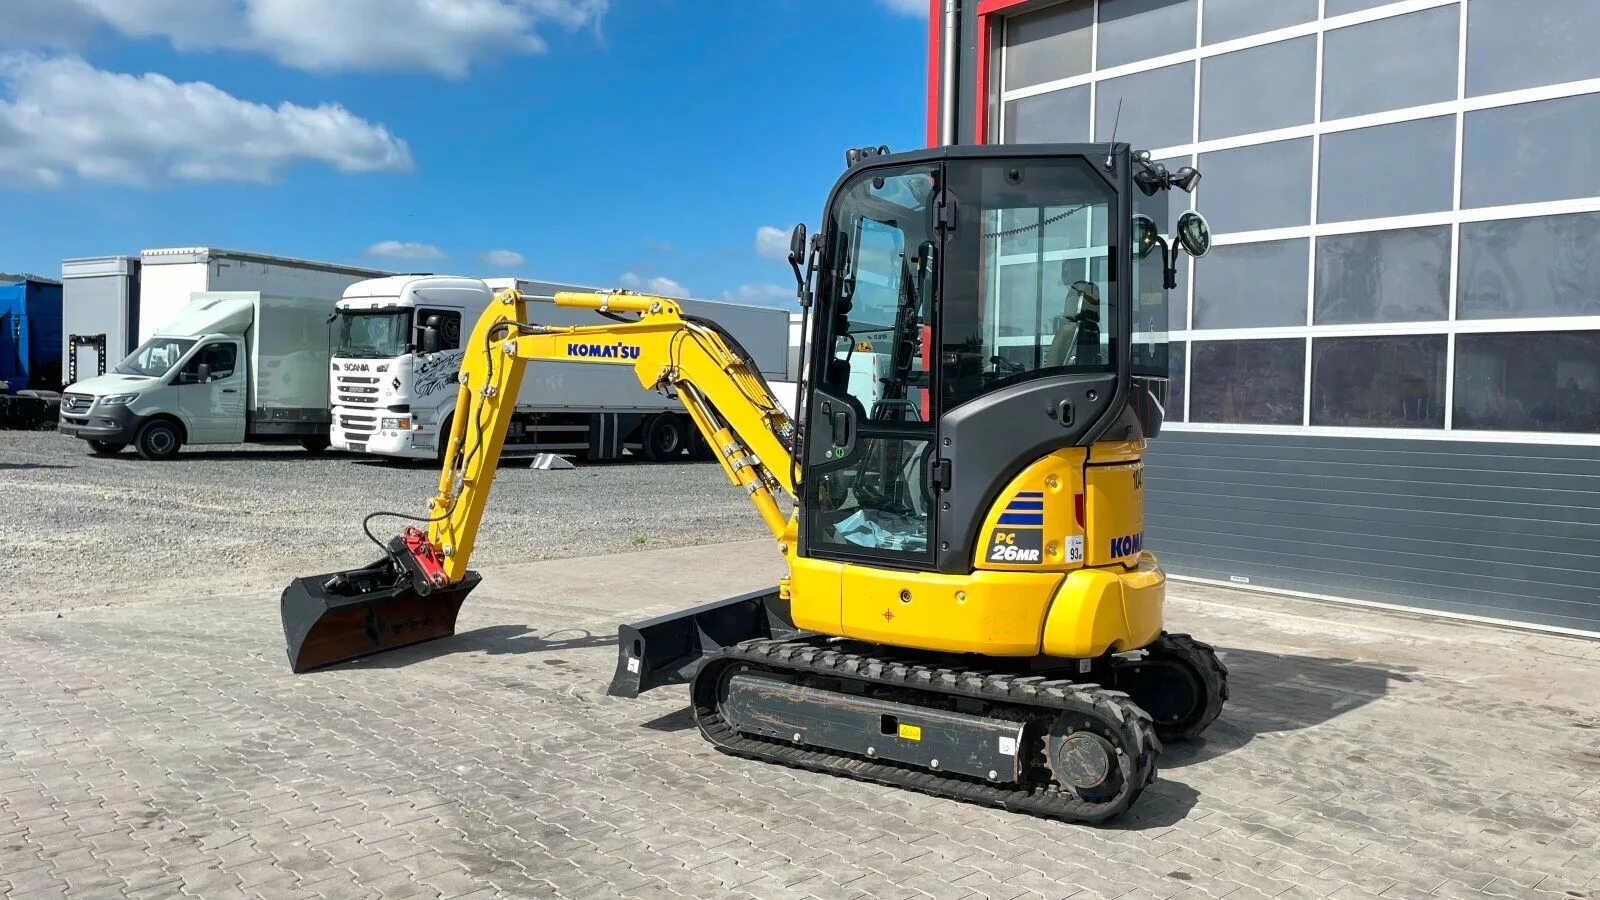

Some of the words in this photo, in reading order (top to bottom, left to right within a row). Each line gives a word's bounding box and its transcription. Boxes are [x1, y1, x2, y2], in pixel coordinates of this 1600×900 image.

[567, 342, 640, 359] KOMATSU
[344, 363, 370, 372] SCANIA
[994, 533, 1015, 544] PC
[990, 545, 1040, 561] 26MR
[1070, 547, 1079, 560] 93
